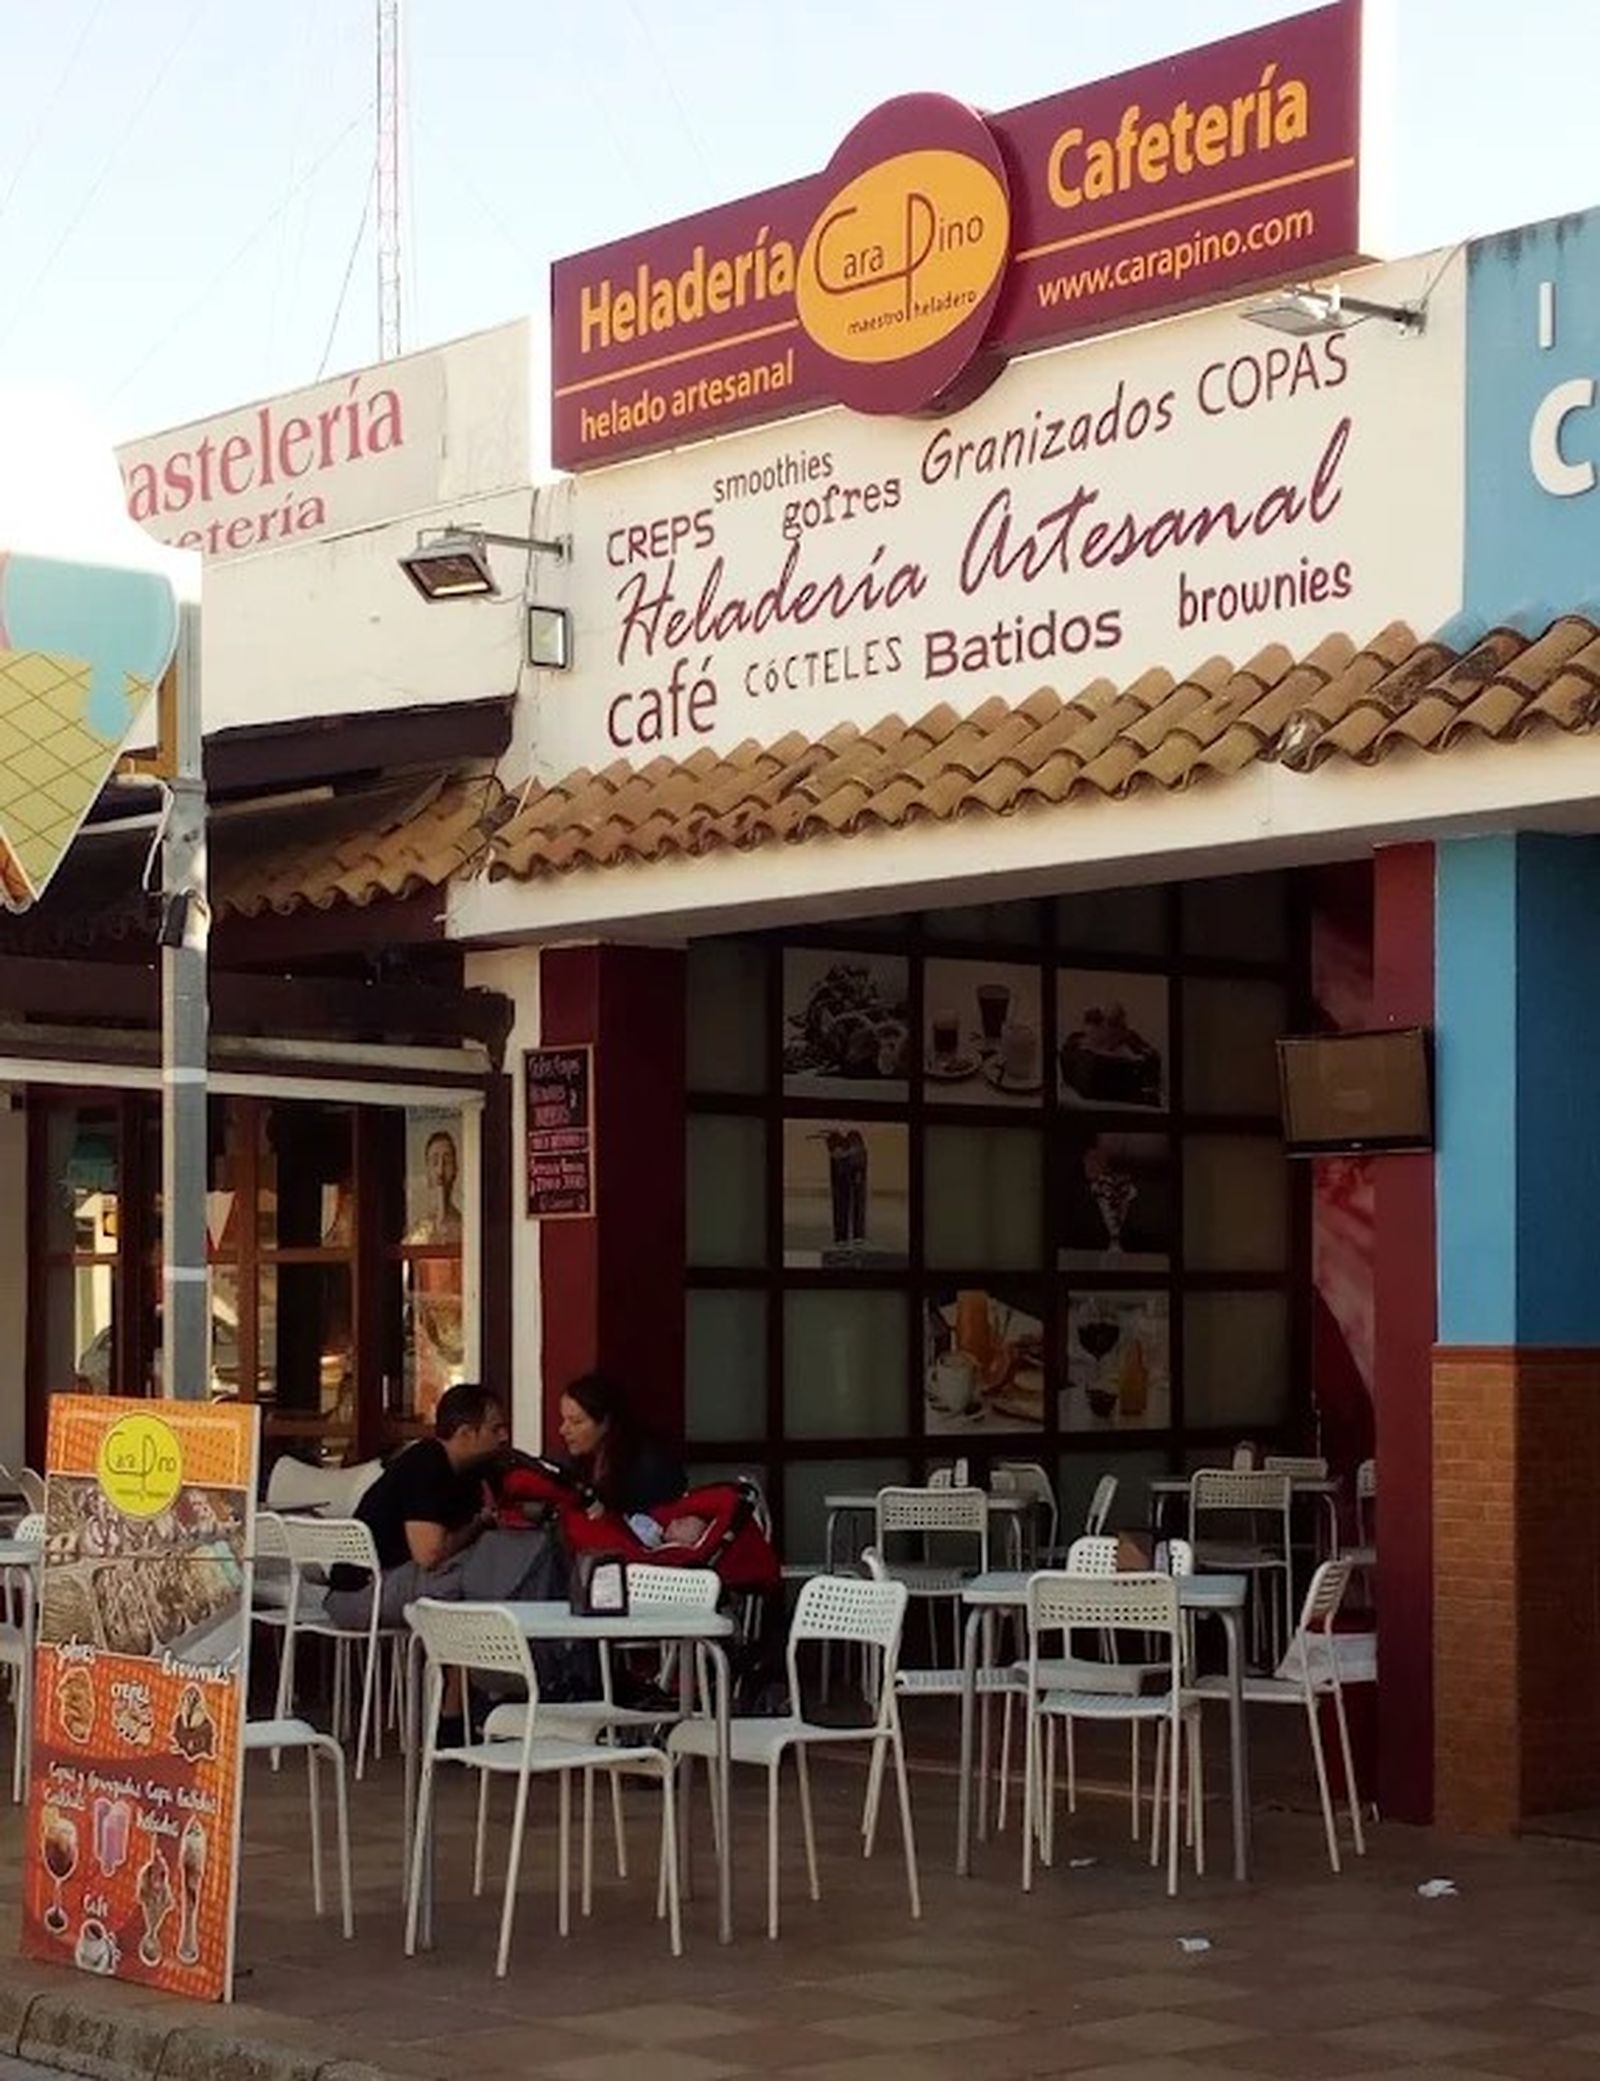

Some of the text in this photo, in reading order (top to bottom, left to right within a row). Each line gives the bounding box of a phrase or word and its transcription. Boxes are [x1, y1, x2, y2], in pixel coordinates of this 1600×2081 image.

[1047, 63, 1308, 208] Cafetería
[580, 225, 795, 354] Heladería
[906, 193, 984, 321] Pino
[1038, 209, 1314, 307] www.carapino.com
[848, 290, 977, 335] maestro heladero
[580, 347, 794, 443] helado artesanal
[1198, 332, 1350, 416] COPAS
[120, 376, 404, 523] astelería
[713, 449, 834, 504] smoothies
[921, 380, 1176, 485] Granizados
[163, 491, 325, 555] etería
[606, 508, 716, 567] CREPS
[616, 416, 1352, 666] Heladería Artesanal
[782, 477, 901, 541] gofres
[1178, 557, 1352, 629] brownies
[923, 608, 1123, 681] Batidos
[607, 655, 718, 748] café
